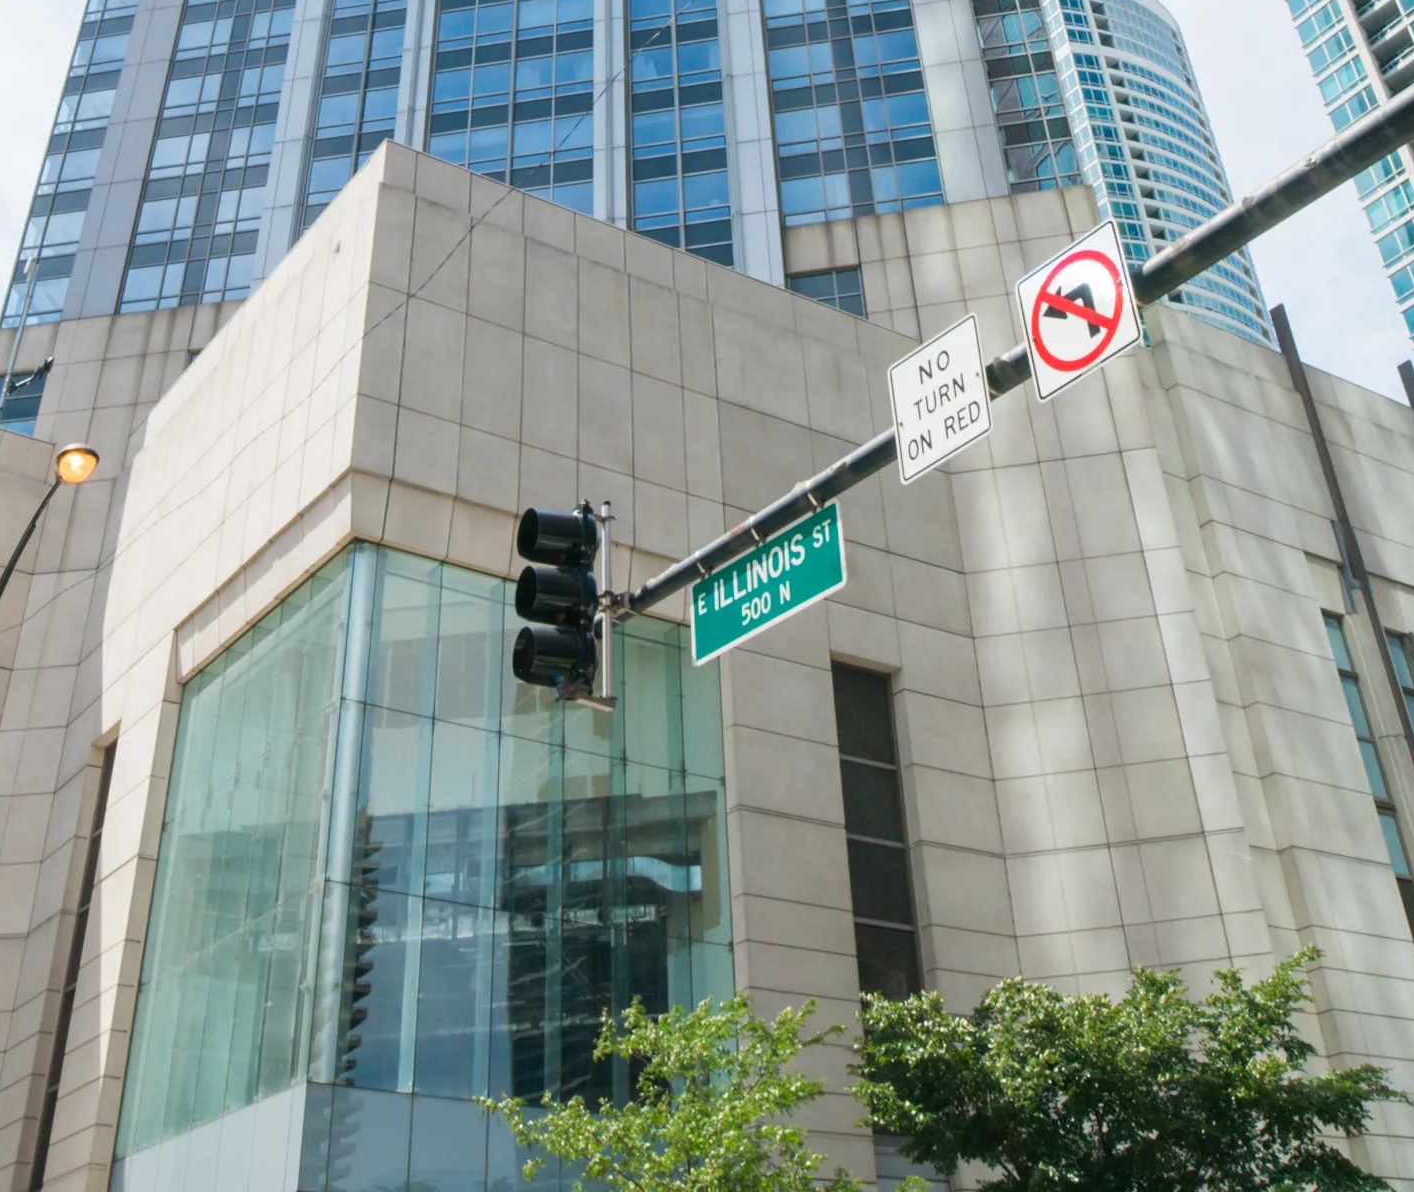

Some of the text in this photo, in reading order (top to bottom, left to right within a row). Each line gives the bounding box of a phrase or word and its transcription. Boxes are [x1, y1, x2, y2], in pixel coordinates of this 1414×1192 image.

[918, 349, 950, 385] NO
[913, 372, 966, 421] TURN
[907, 400, 981, 461] ON RED
[697, 519, 832, 616] E ILLINOIS ST
[741, 580, 791, 627] 500 N
